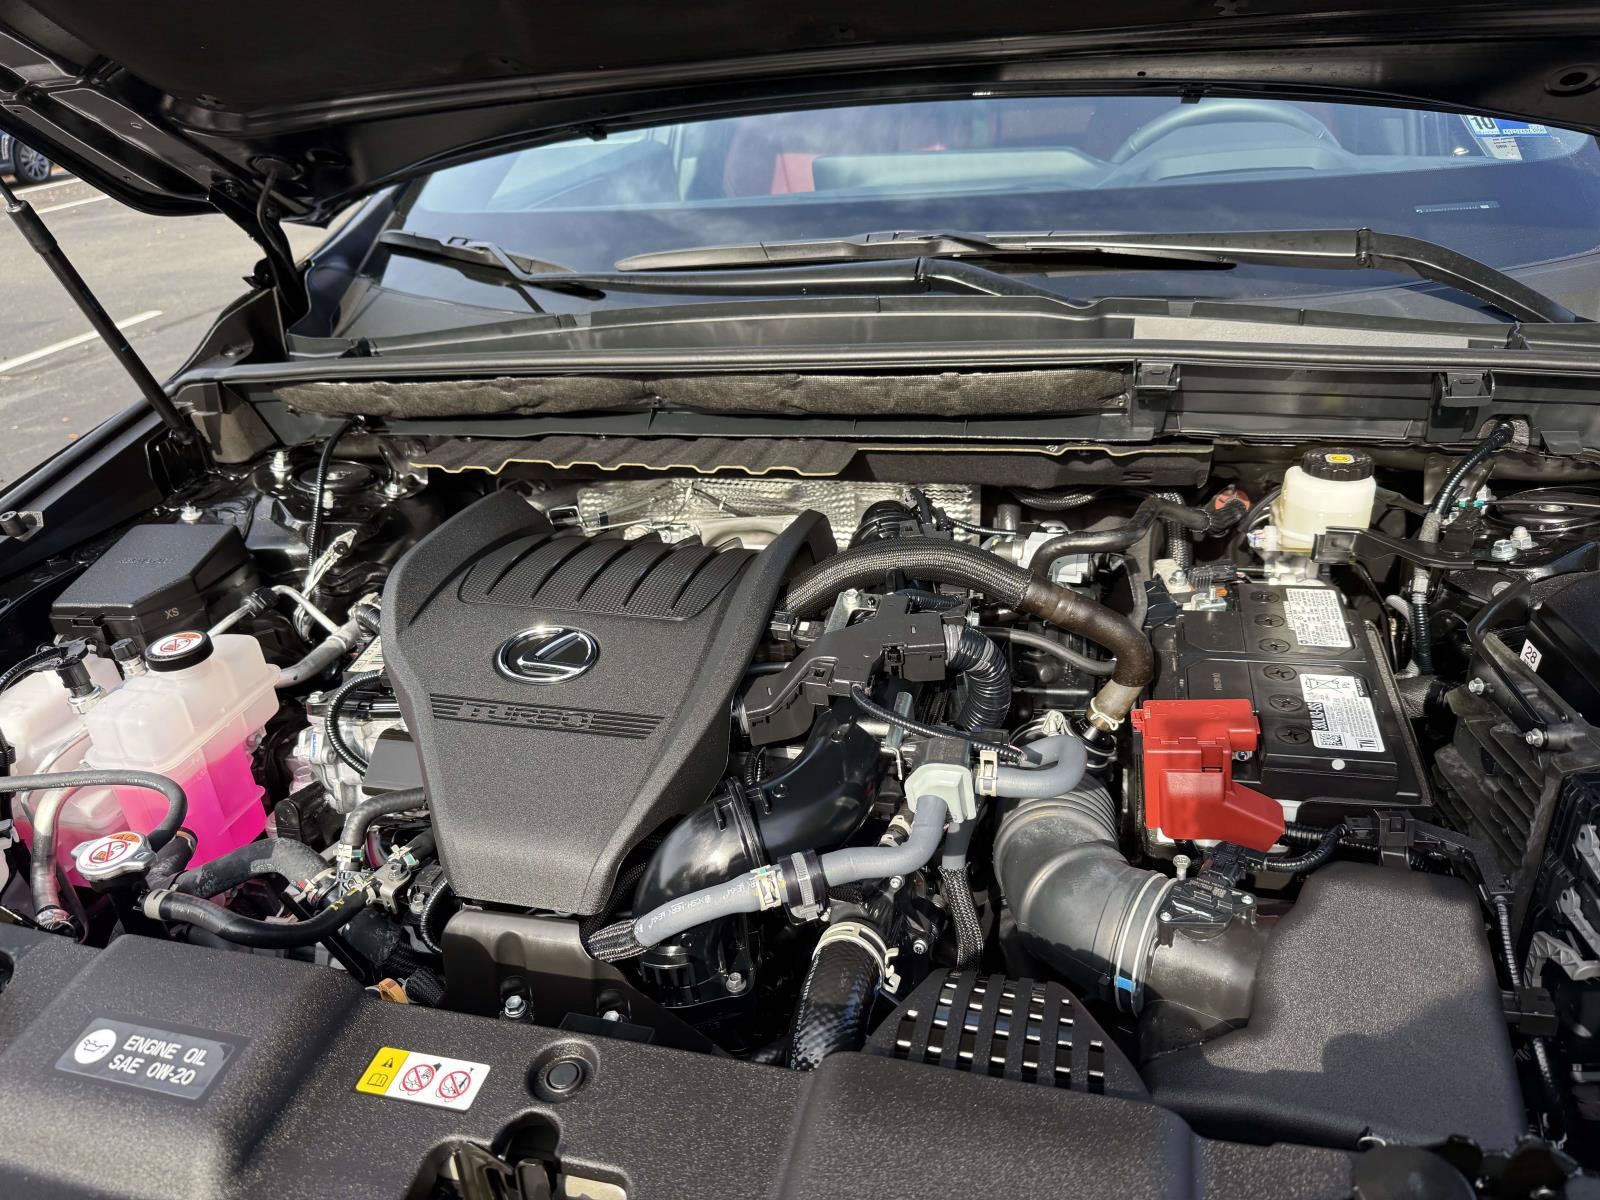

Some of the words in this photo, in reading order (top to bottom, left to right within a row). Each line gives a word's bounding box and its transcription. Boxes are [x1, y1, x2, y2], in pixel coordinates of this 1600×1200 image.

[164, 607, 180, 620] XS
[1525, 646, 1537, 663] 28
[123, 1035, 181, 1059] ENGINE
[184, 1048, 207, 1066] OIL
[108, 1054, 144, 1074] SAE
[146, 1062, 196, 1085] 0W-20
